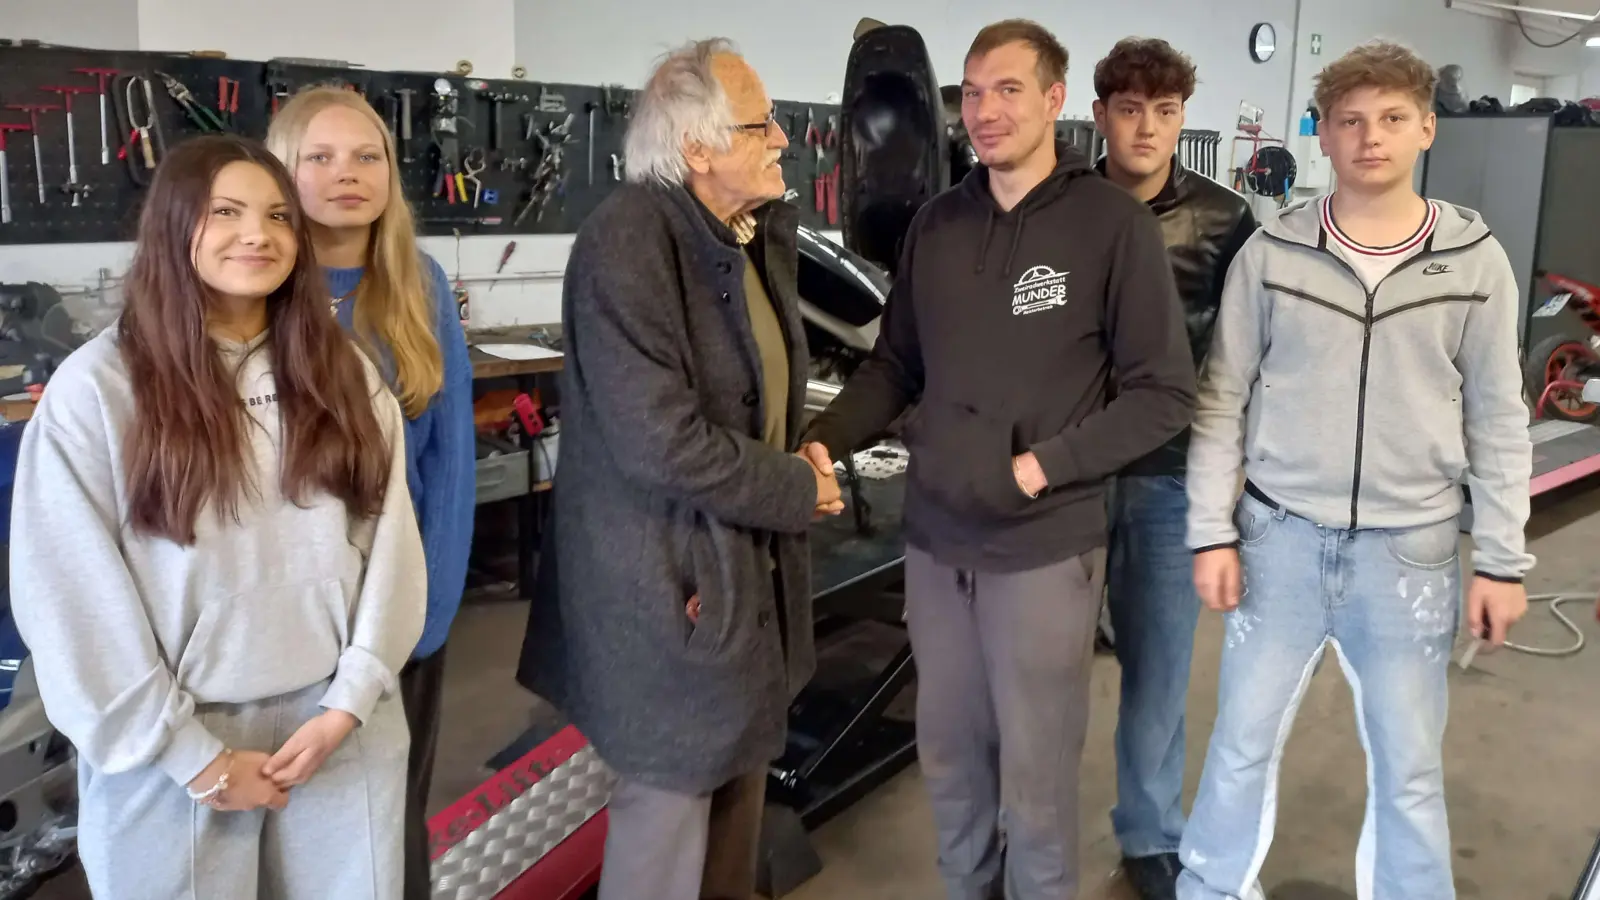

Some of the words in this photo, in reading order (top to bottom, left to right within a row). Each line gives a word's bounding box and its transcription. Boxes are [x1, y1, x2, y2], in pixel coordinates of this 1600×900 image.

[1428, 262, 1450, 272] NIKE
[1013, 277, 1067, 294] Zweiradwerkstatt
[1011, 284, 1067, 307] MUNDER
[249, 396, 263, 407] BE
[264, 393, 278, 404] RE
